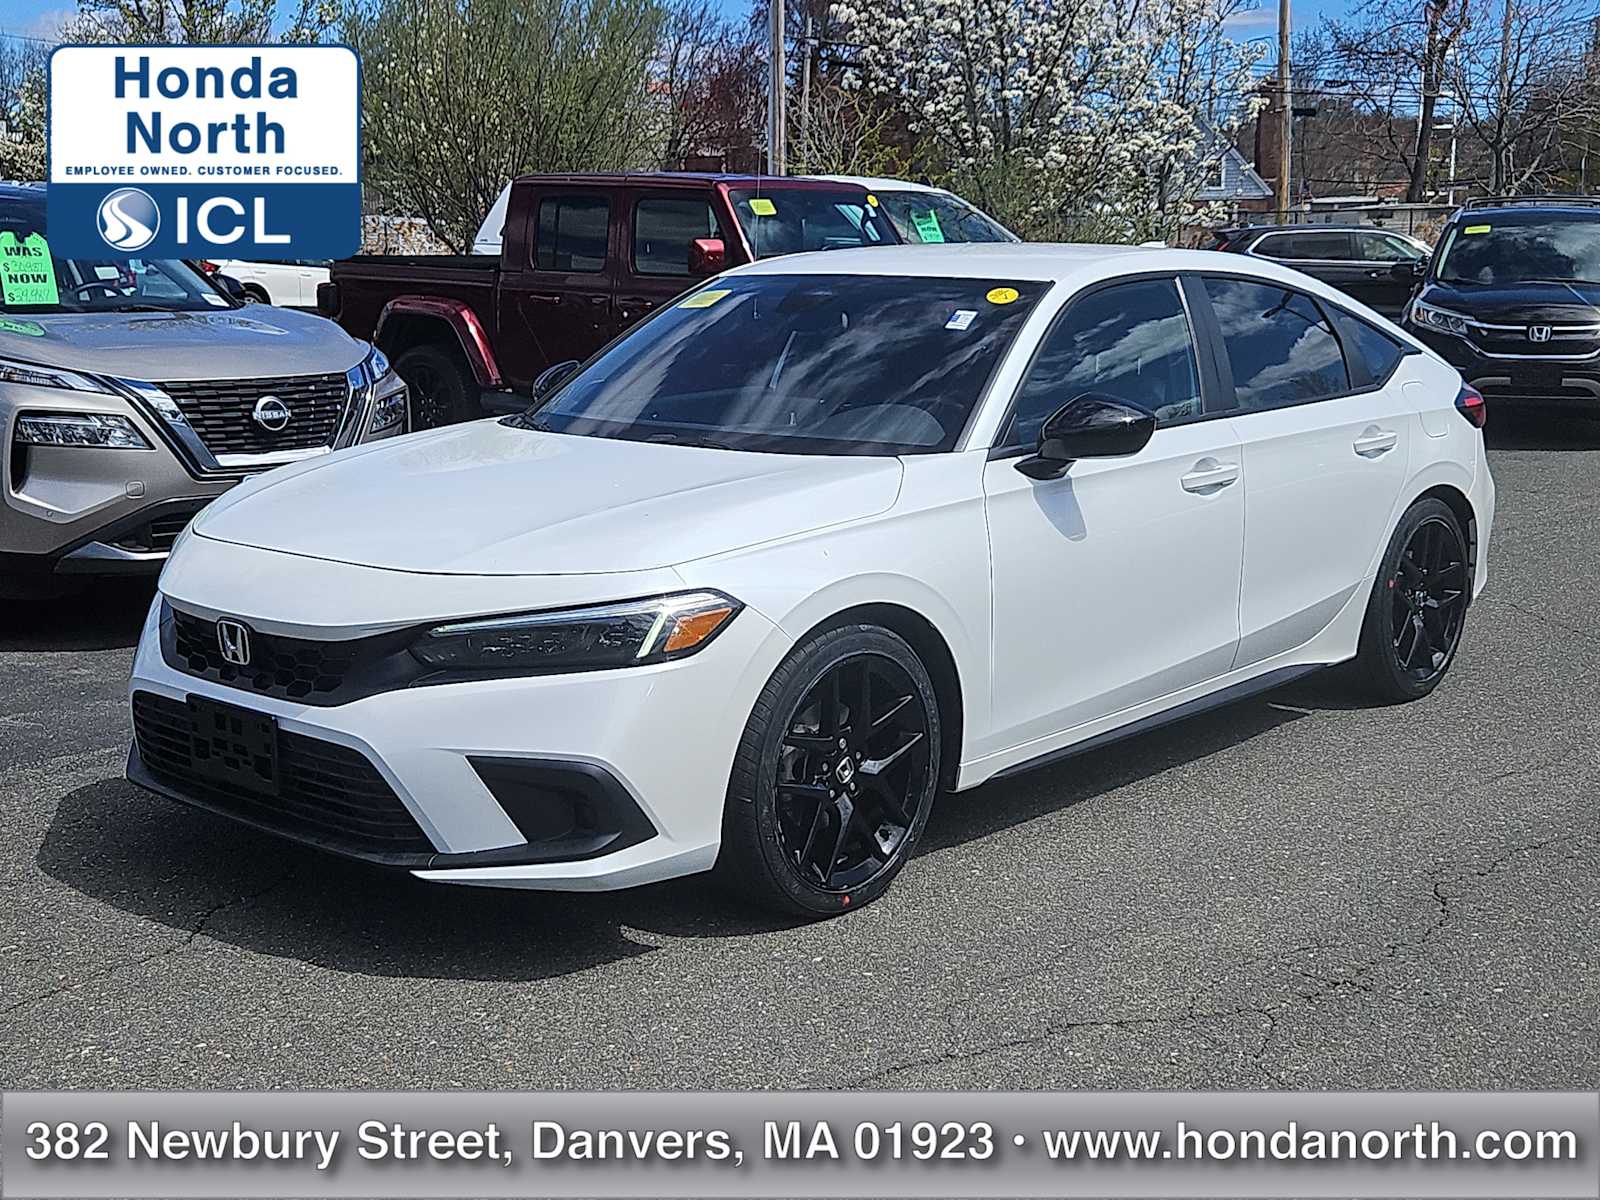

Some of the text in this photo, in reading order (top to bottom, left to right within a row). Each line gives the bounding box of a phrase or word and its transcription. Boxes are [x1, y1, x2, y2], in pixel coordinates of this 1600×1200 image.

[3, 246, 43, 257] WAS
[8, 273, 48, 284] NOW
[252, 409, 292, 420] NISSAN
